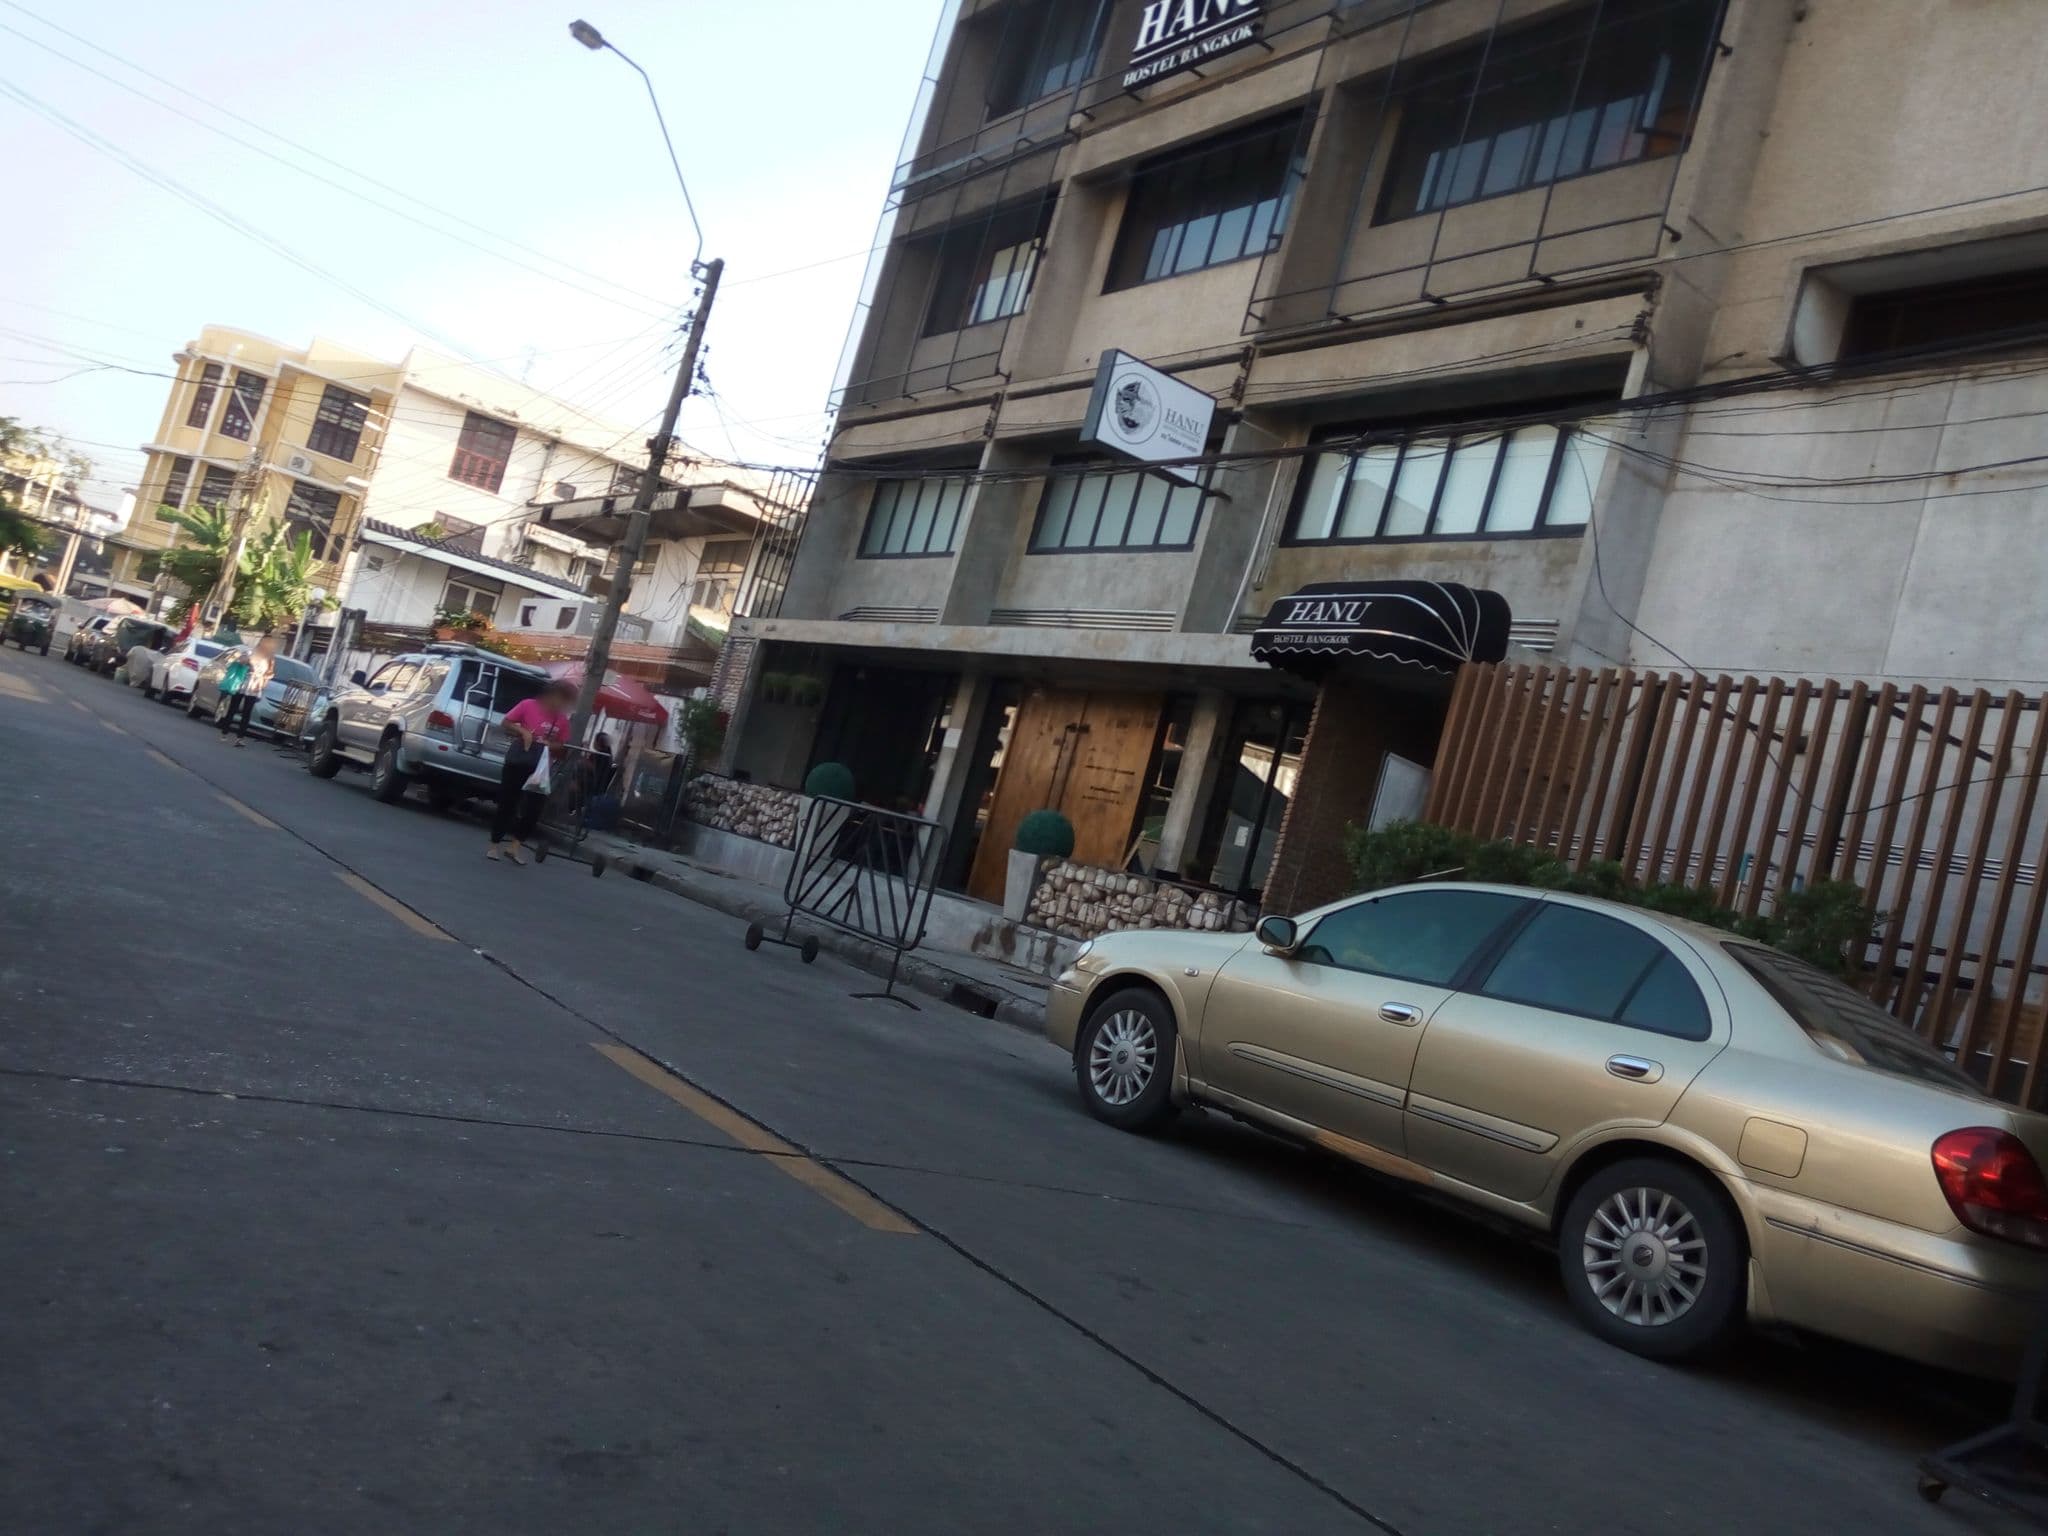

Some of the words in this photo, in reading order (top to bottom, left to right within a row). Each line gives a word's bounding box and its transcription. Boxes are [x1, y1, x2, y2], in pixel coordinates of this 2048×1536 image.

[1132, 0, 1255, 52] HA
[1122, 54, 1176, 87] HOSTEL
[1180, 23, 1254, 63] BANGKOK
[1164, 407, 1204, 437] HANU
[1284, 601, 1373, 622] HANU
[1273, 634, 1305, 644] HOSTEL
[1306, 634, 1351, 644] BANGKOK
